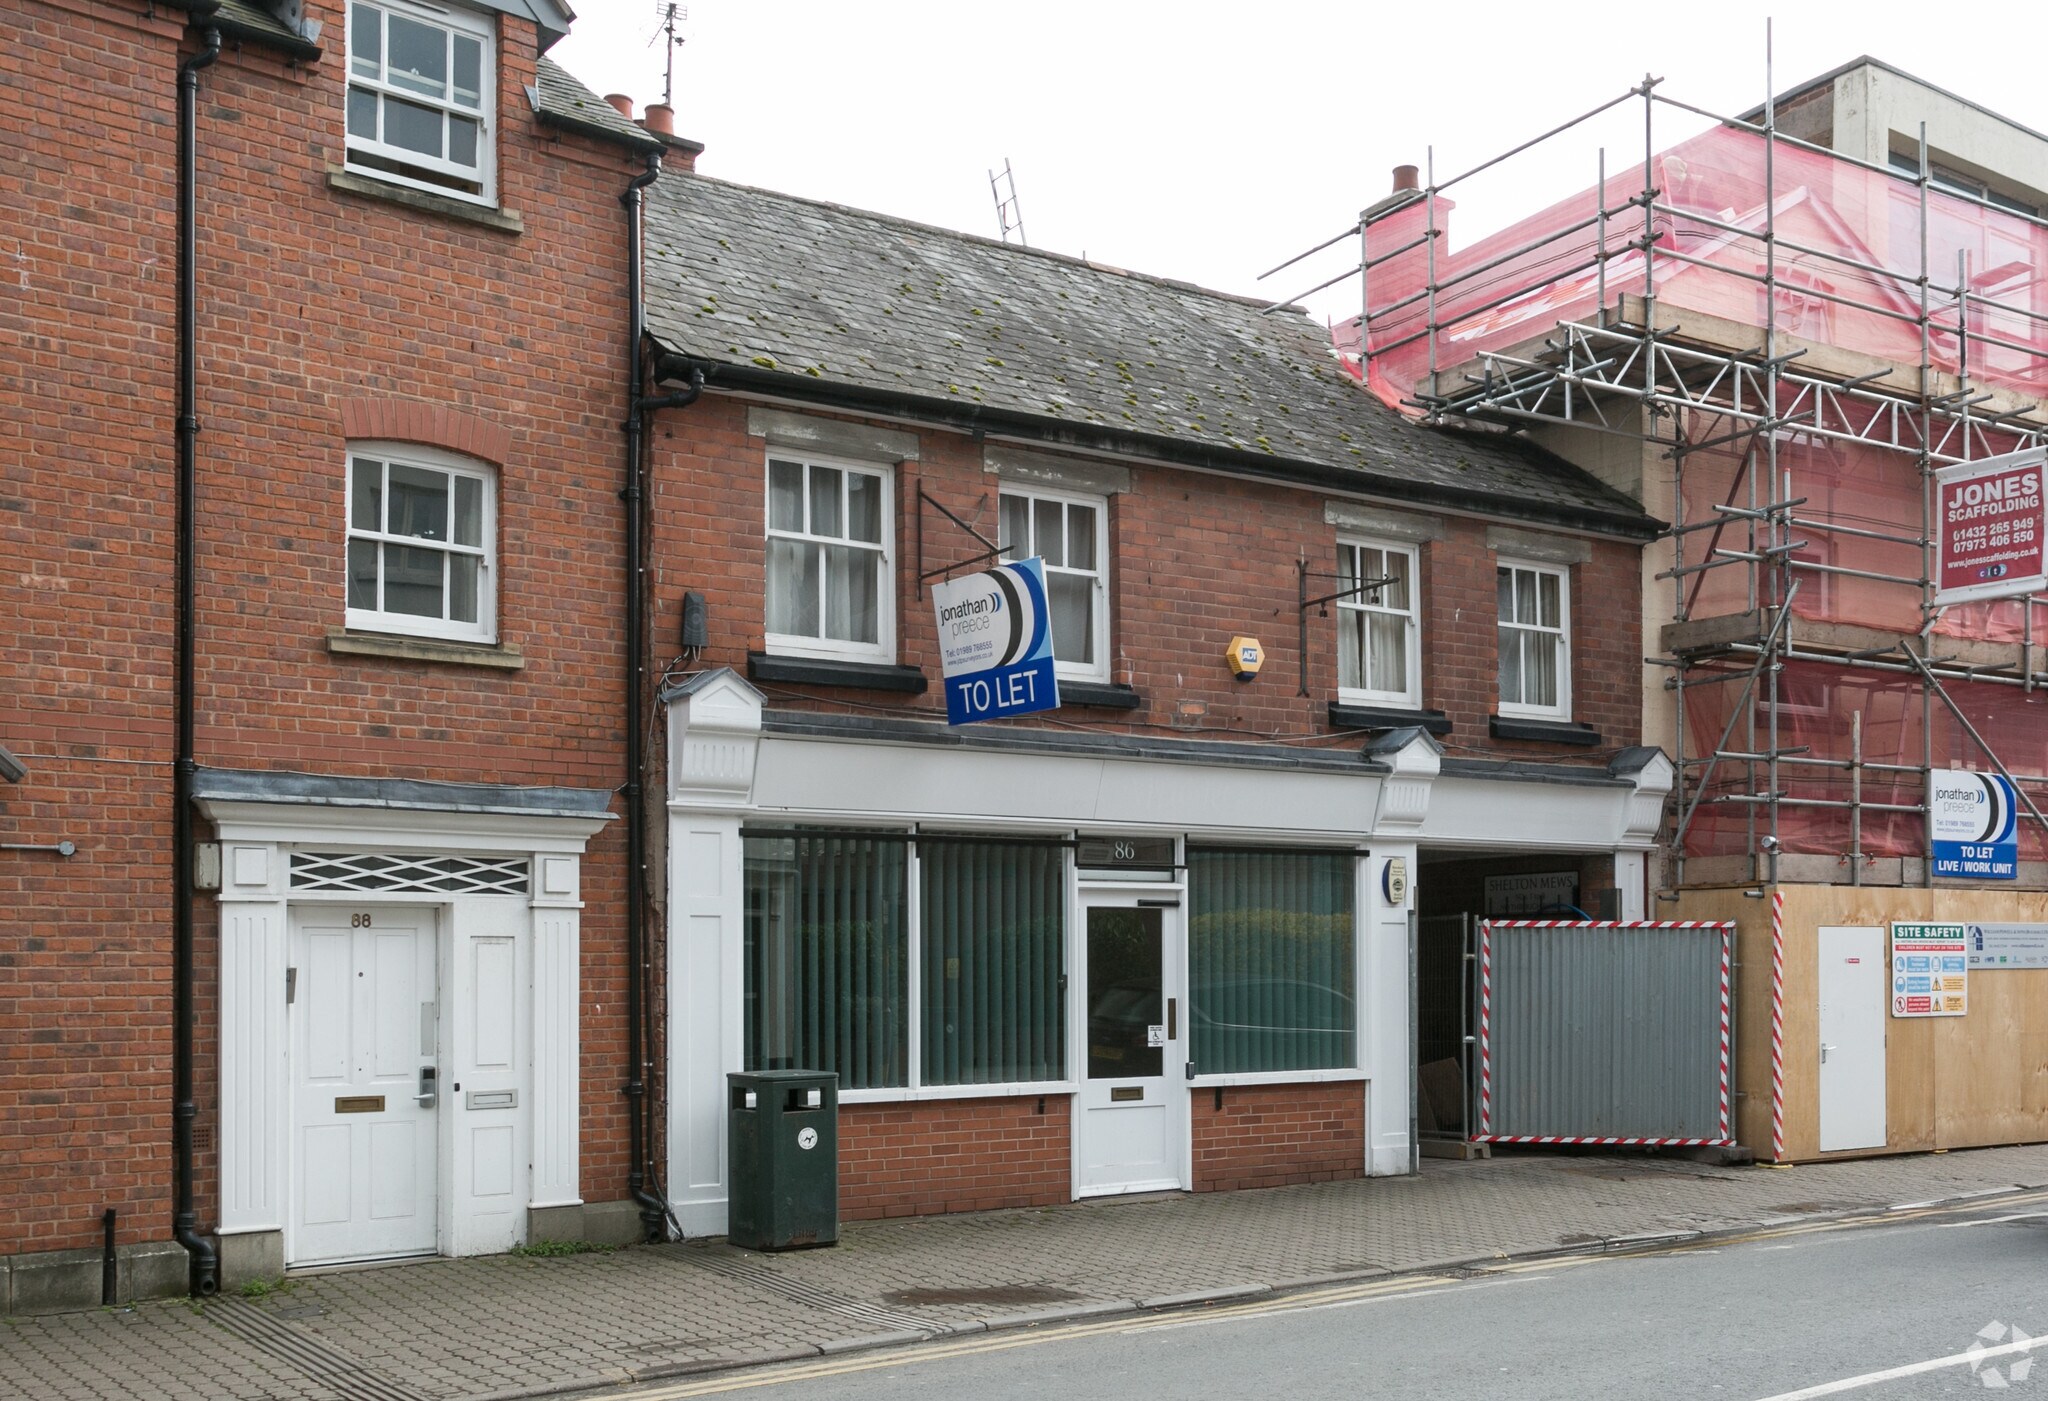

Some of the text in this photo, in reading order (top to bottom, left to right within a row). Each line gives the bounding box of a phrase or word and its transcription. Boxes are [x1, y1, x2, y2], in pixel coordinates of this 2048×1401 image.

[1948, 473, 2040, 510] JONES
[1948, 494, 2040, 523] SCAFFOLDING
[1953, 517, 2034, 542] 01432 265 949
[1953, 529, 2034, 554] 07973 406 550
[1947, 545, 2040, 569] www.jonesscaffolding.co.uk
[939, 598, 988, 627] jonathan
[951, 615, 990, 640] preece
[1242, 650, 1258, 660] ADT
[958, 669, 1038, 715] TO LET
[1935, 786, 1975, 802] jonathan
[1943, 801, 1975, 814] preece
[1114, 840, 1135, 860] 86
[1960, 845, 1995, 859] TO LET
[1992, 863, 2013, 875] UNIT
[1489, 875, 1574, 892] SHELTON MEWS
[351, 913, 372, 928] 88
[1897, 926, 1962, 938] SITE SAFETY
